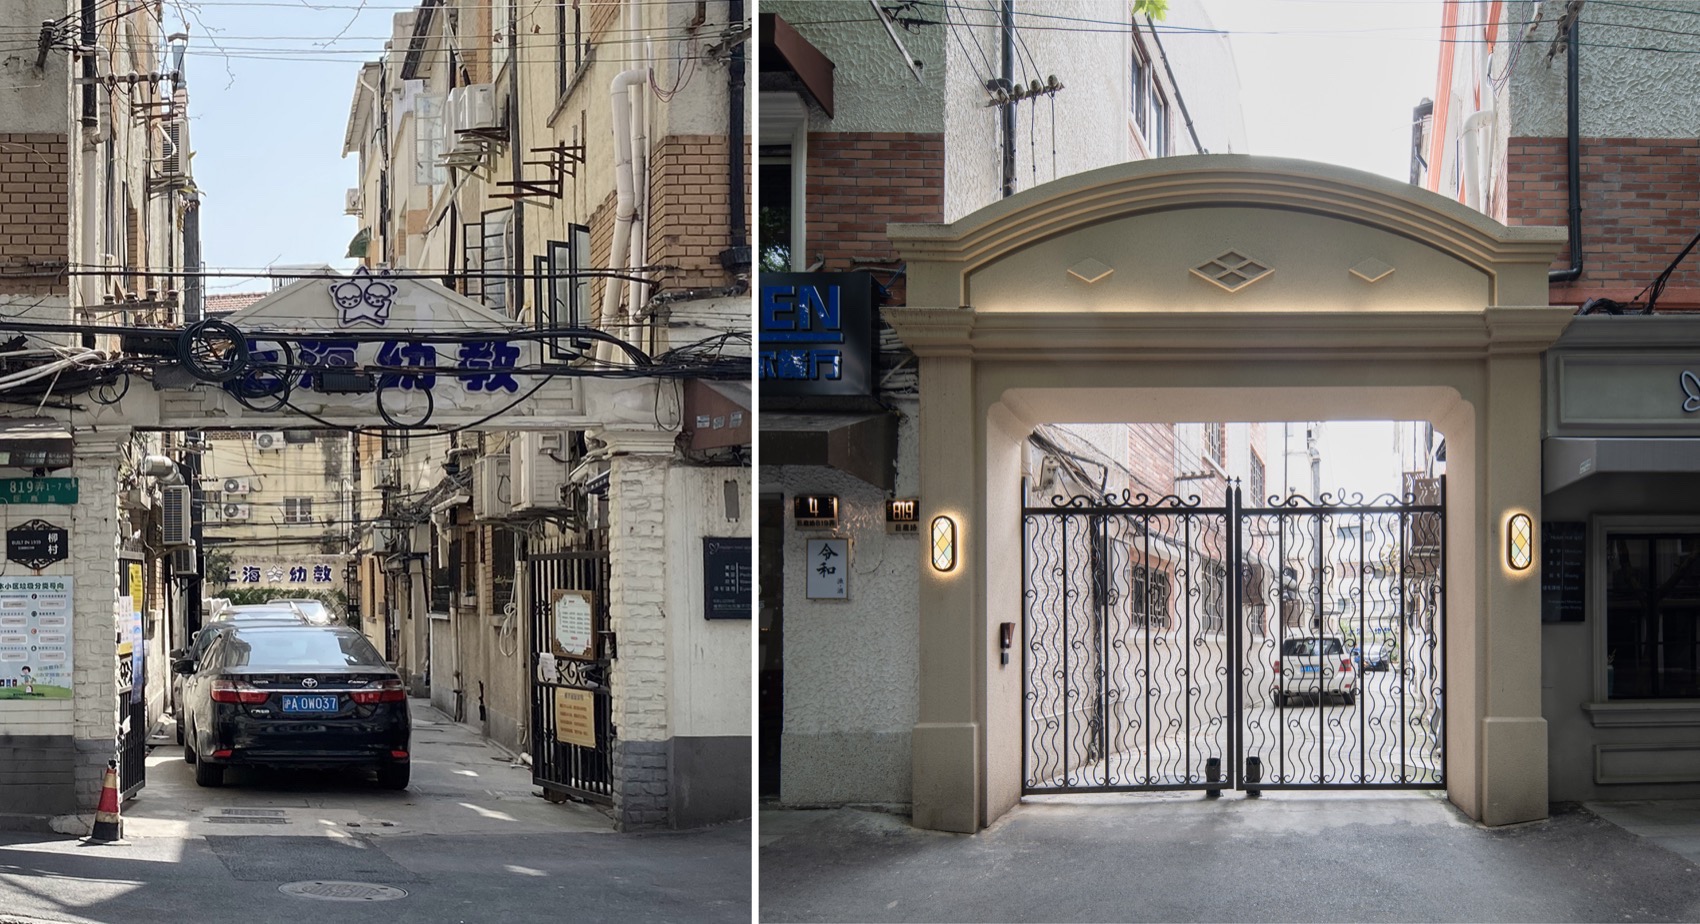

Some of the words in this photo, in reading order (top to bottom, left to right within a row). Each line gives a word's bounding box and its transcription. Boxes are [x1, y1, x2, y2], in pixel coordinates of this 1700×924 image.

[763, 286, 841, 330] EN
[808, 497, 819, 517] 4
[892, 500, 914, 520] 819
[816, 543, 839, 579] 令和
